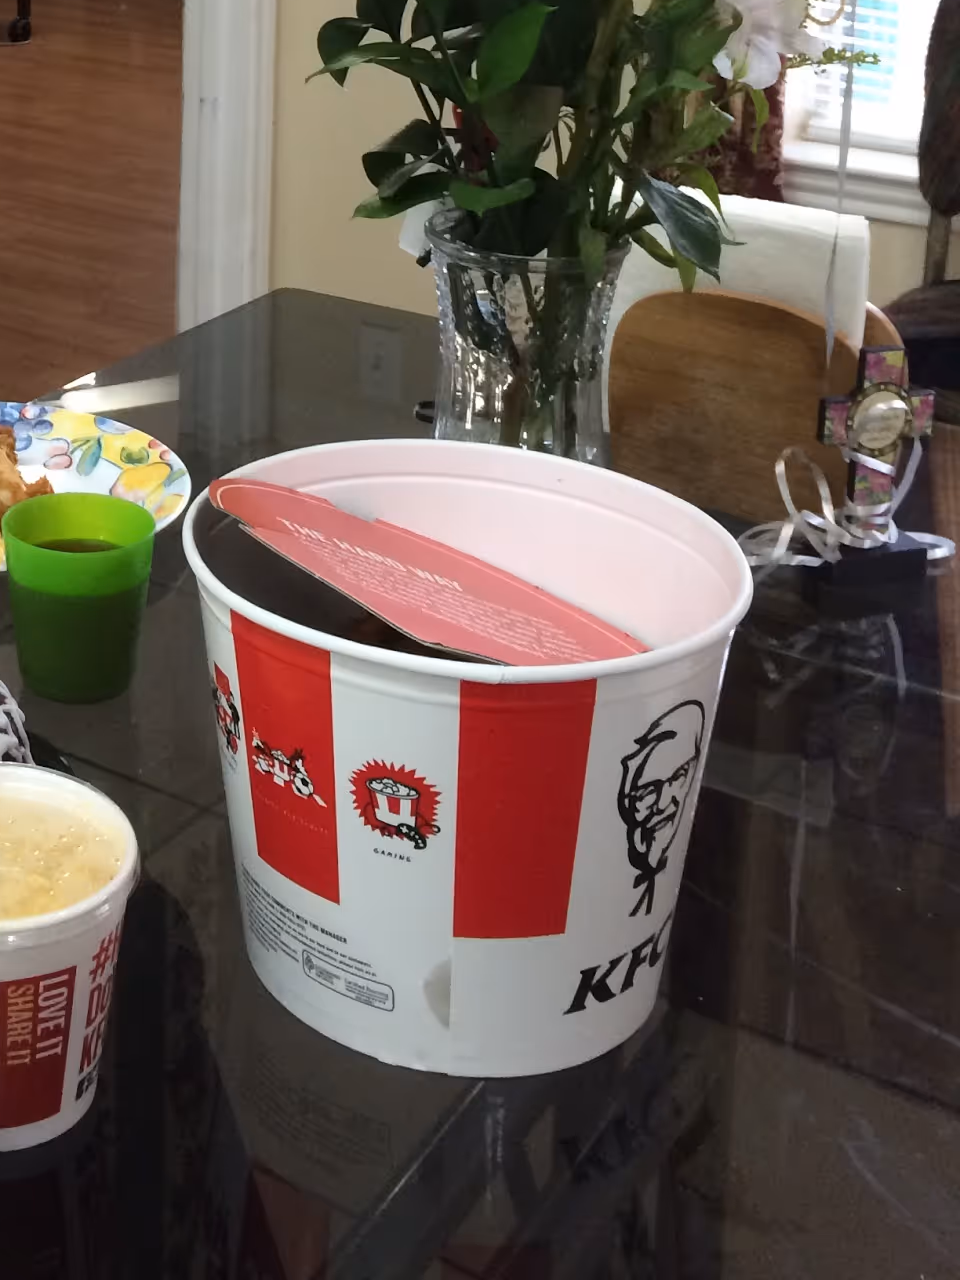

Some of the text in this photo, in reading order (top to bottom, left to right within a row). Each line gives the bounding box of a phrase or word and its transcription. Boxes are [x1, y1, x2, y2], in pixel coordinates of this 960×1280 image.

[373, 846, 412, 863] GAMING
[6, 983, 35, 1066] SHARE IT
[35, 973, 70, 1059] LOVE IT
